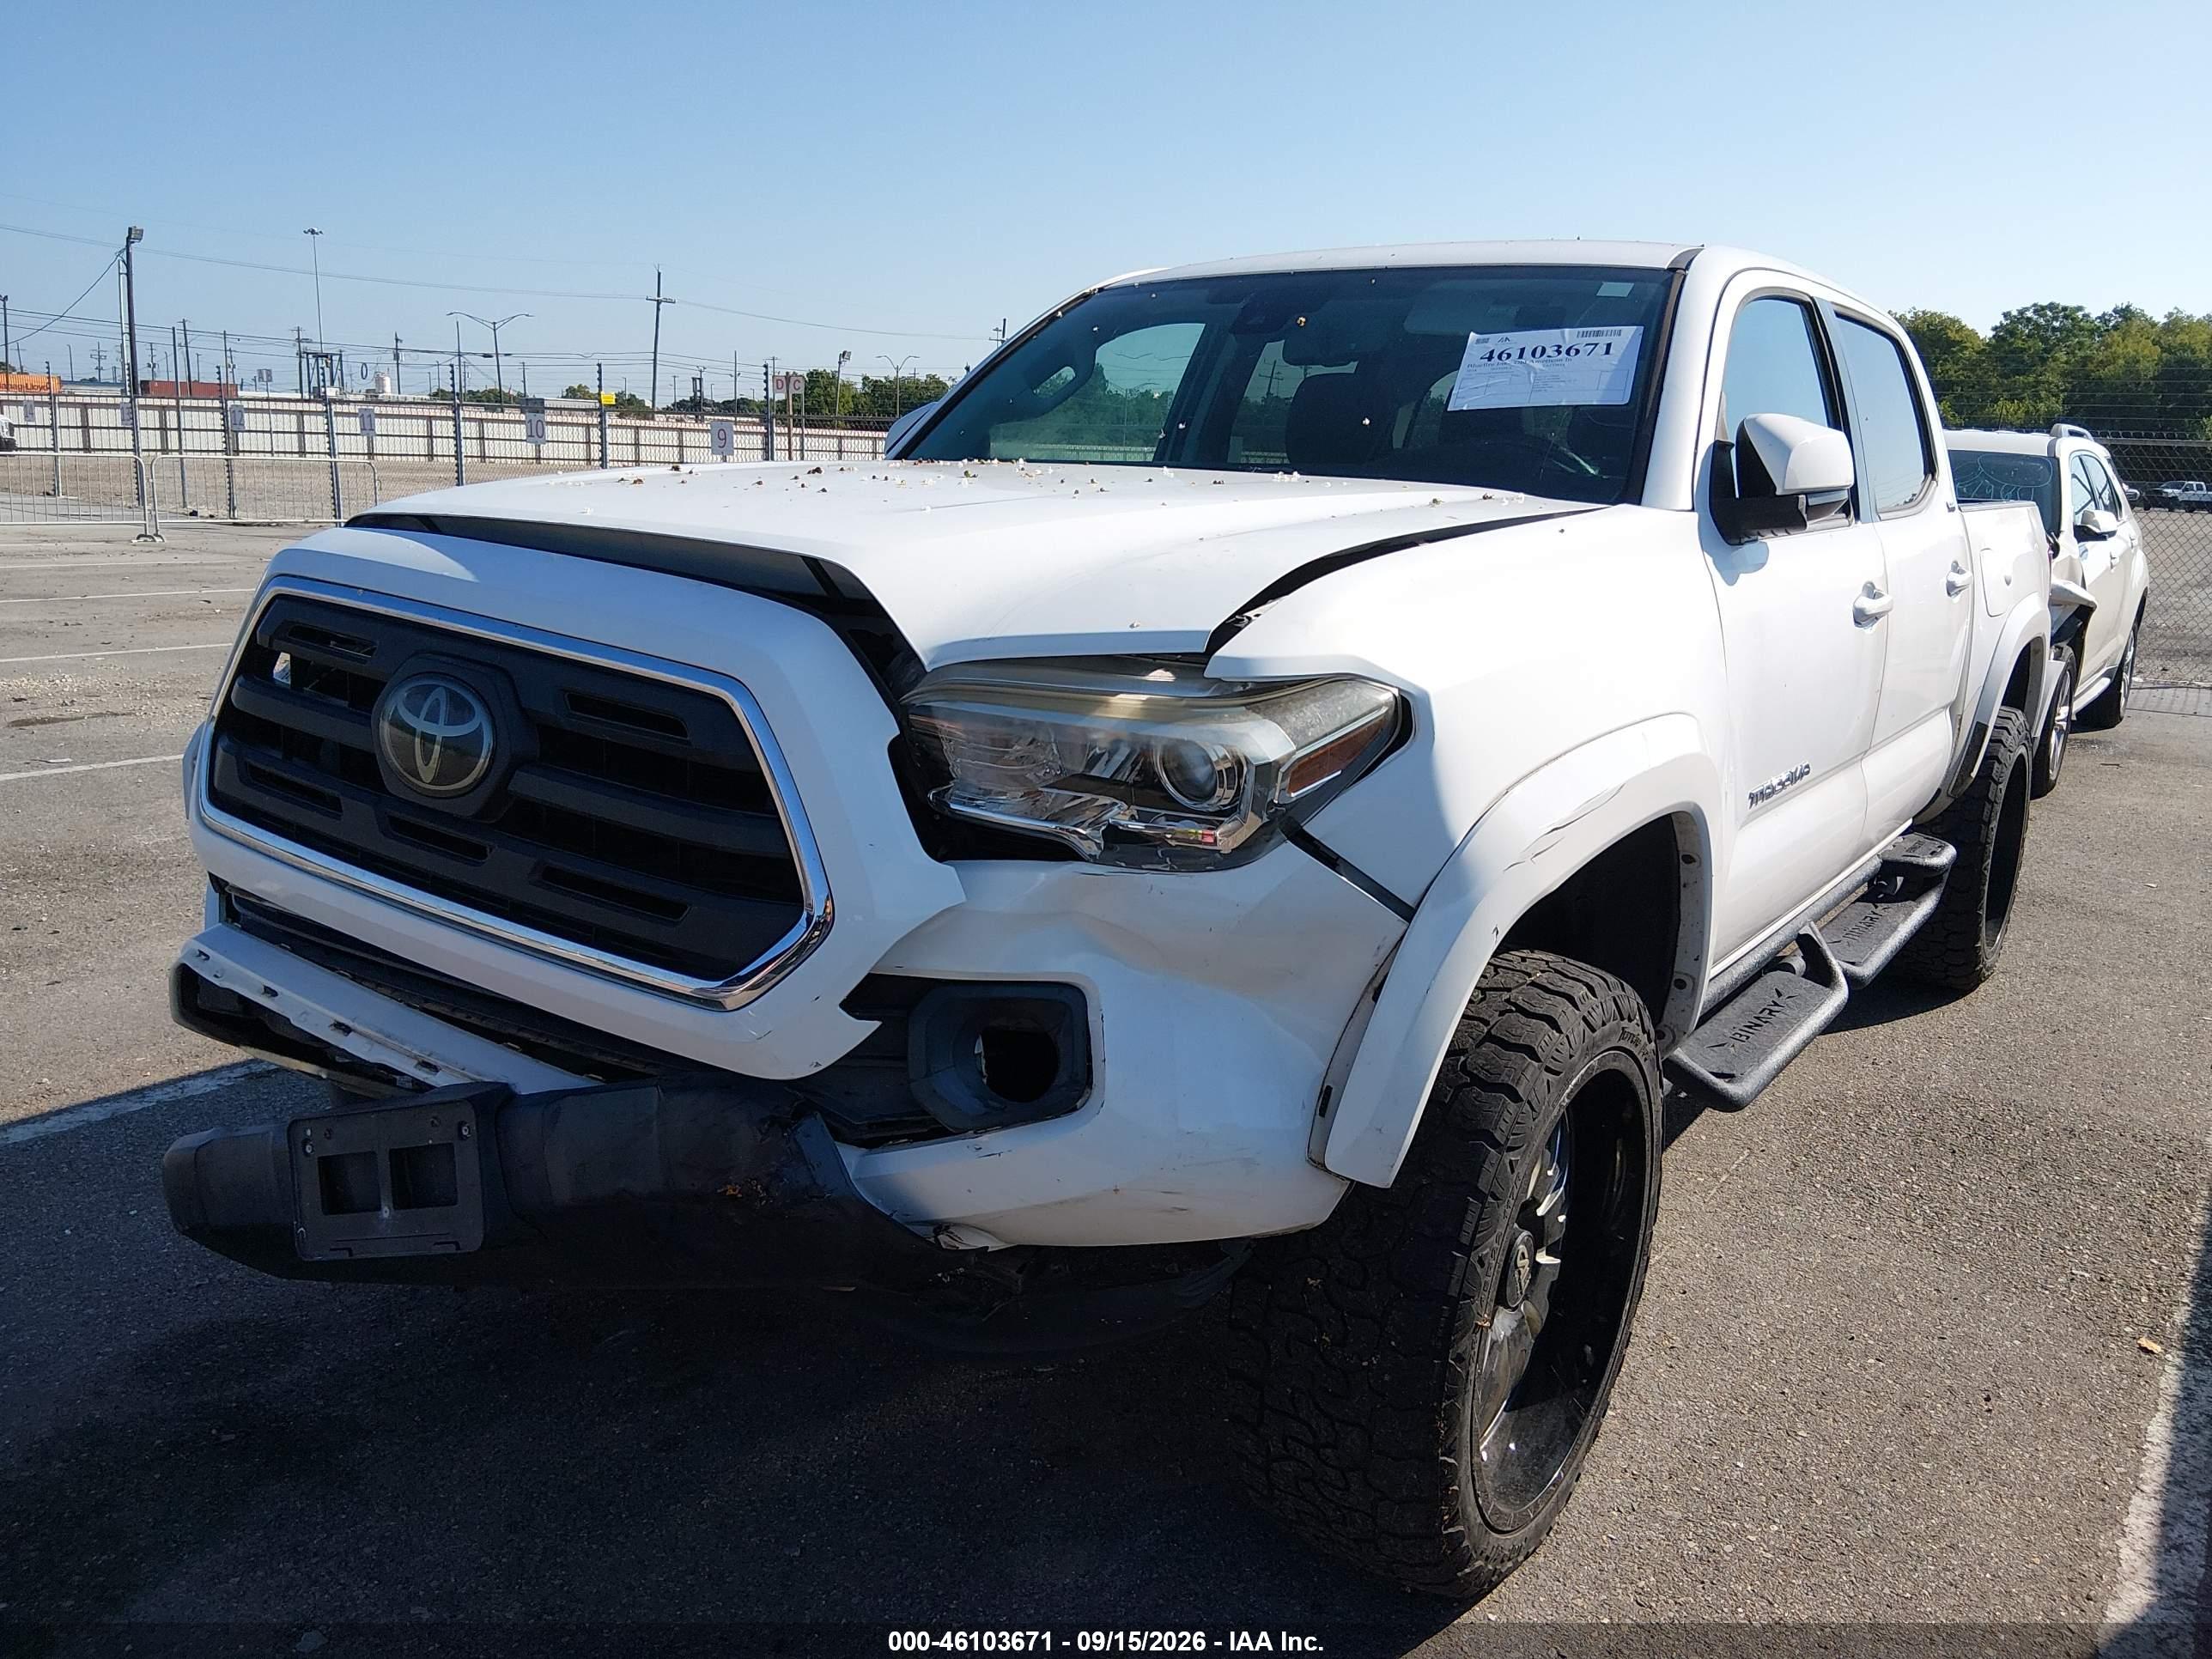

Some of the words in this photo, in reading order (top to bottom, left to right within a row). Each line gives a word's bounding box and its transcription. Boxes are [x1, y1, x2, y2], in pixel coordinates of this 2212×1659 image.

[1480, 341, 1615, 362] 46103671
[775, 379, 784, 390] D
[793, 379, 801, 391] C
[231, 408, 245, 425] 12
[359, 413, 374, 431] 11
[526, 418, 545, 440] 10
[716, 427, 728, 449] 9
[1729, 1000, 1785, 1042] BINARY
